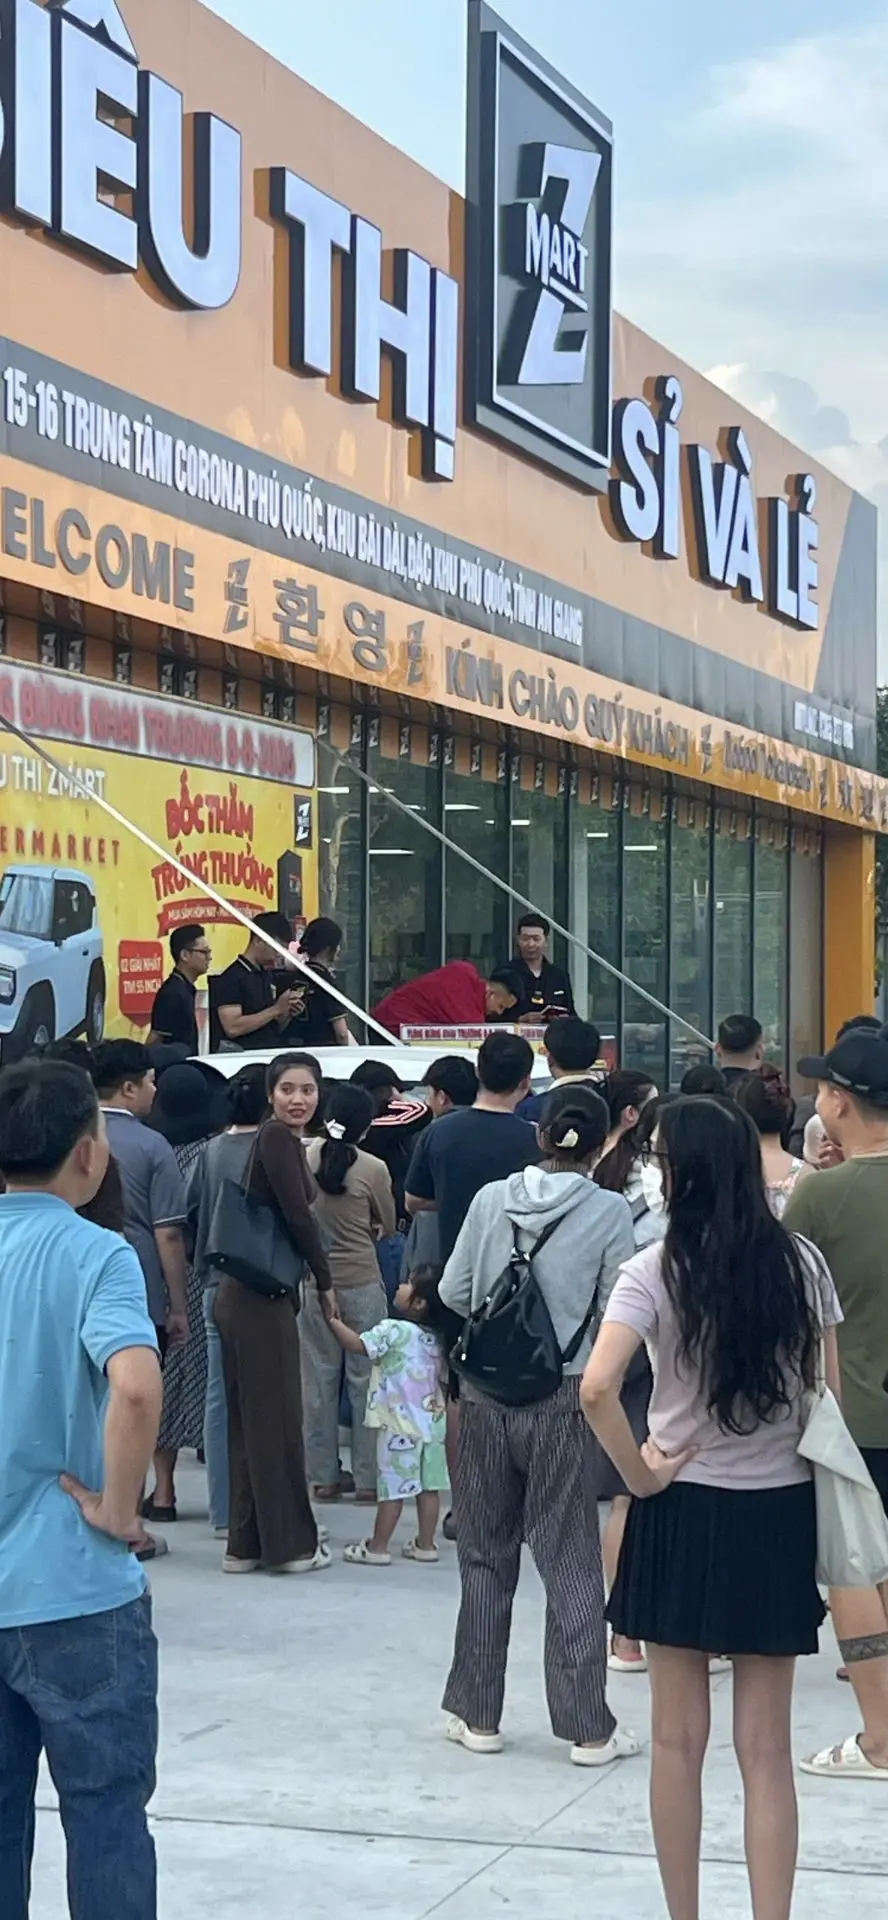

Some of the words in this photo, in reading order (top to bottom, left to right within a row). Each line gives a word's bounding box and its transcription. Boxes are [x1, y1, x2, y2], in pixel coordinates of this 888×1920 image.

[0, 0, 241, 309] IÊU
[278, 167, 459, 482] THỊ
[525, 203, 588, 293] MART
[3, 366, 59, 440] 15-16
[61, 390, 131, 470] TRUNG
[133, 414, 173, 487] TÂM
[174, 439, 246, 516] CORONA
[247, 470, 280, 528] PHÚ
[281, 478, 325, 552] QUỐC,
[326, 503, 356, 558] KHU
[358, 512, 381, 568] BÃI
[407, 532, 432, 591] ĐẶC
[433, 547, 458, 596] KHU
[460, 557, 482, 606] PHÚ
[483, 560, 513, 624] QUỐC,
[537, 592, 552, 635] AN
[553, 600, 583, 647] GIANG
[614, 375, 683, 559] SỈ
[694, 427, 764, 602] VÀ
[773, 473, 819, 630] LẺ
[445, 638, 504, 709] KÍNH
[509, 667, 579, 731] CHÀO
[584, 691, 625, 746] QUÝ
[627, 707, 689, 767] KHÁCH
[12, 755, 42, 802] THỊ
[165, 768, 204, 840] BỐC
[205, 782, 254, 841] THĂM
[151, 840, 208, 900] TRÚNG
